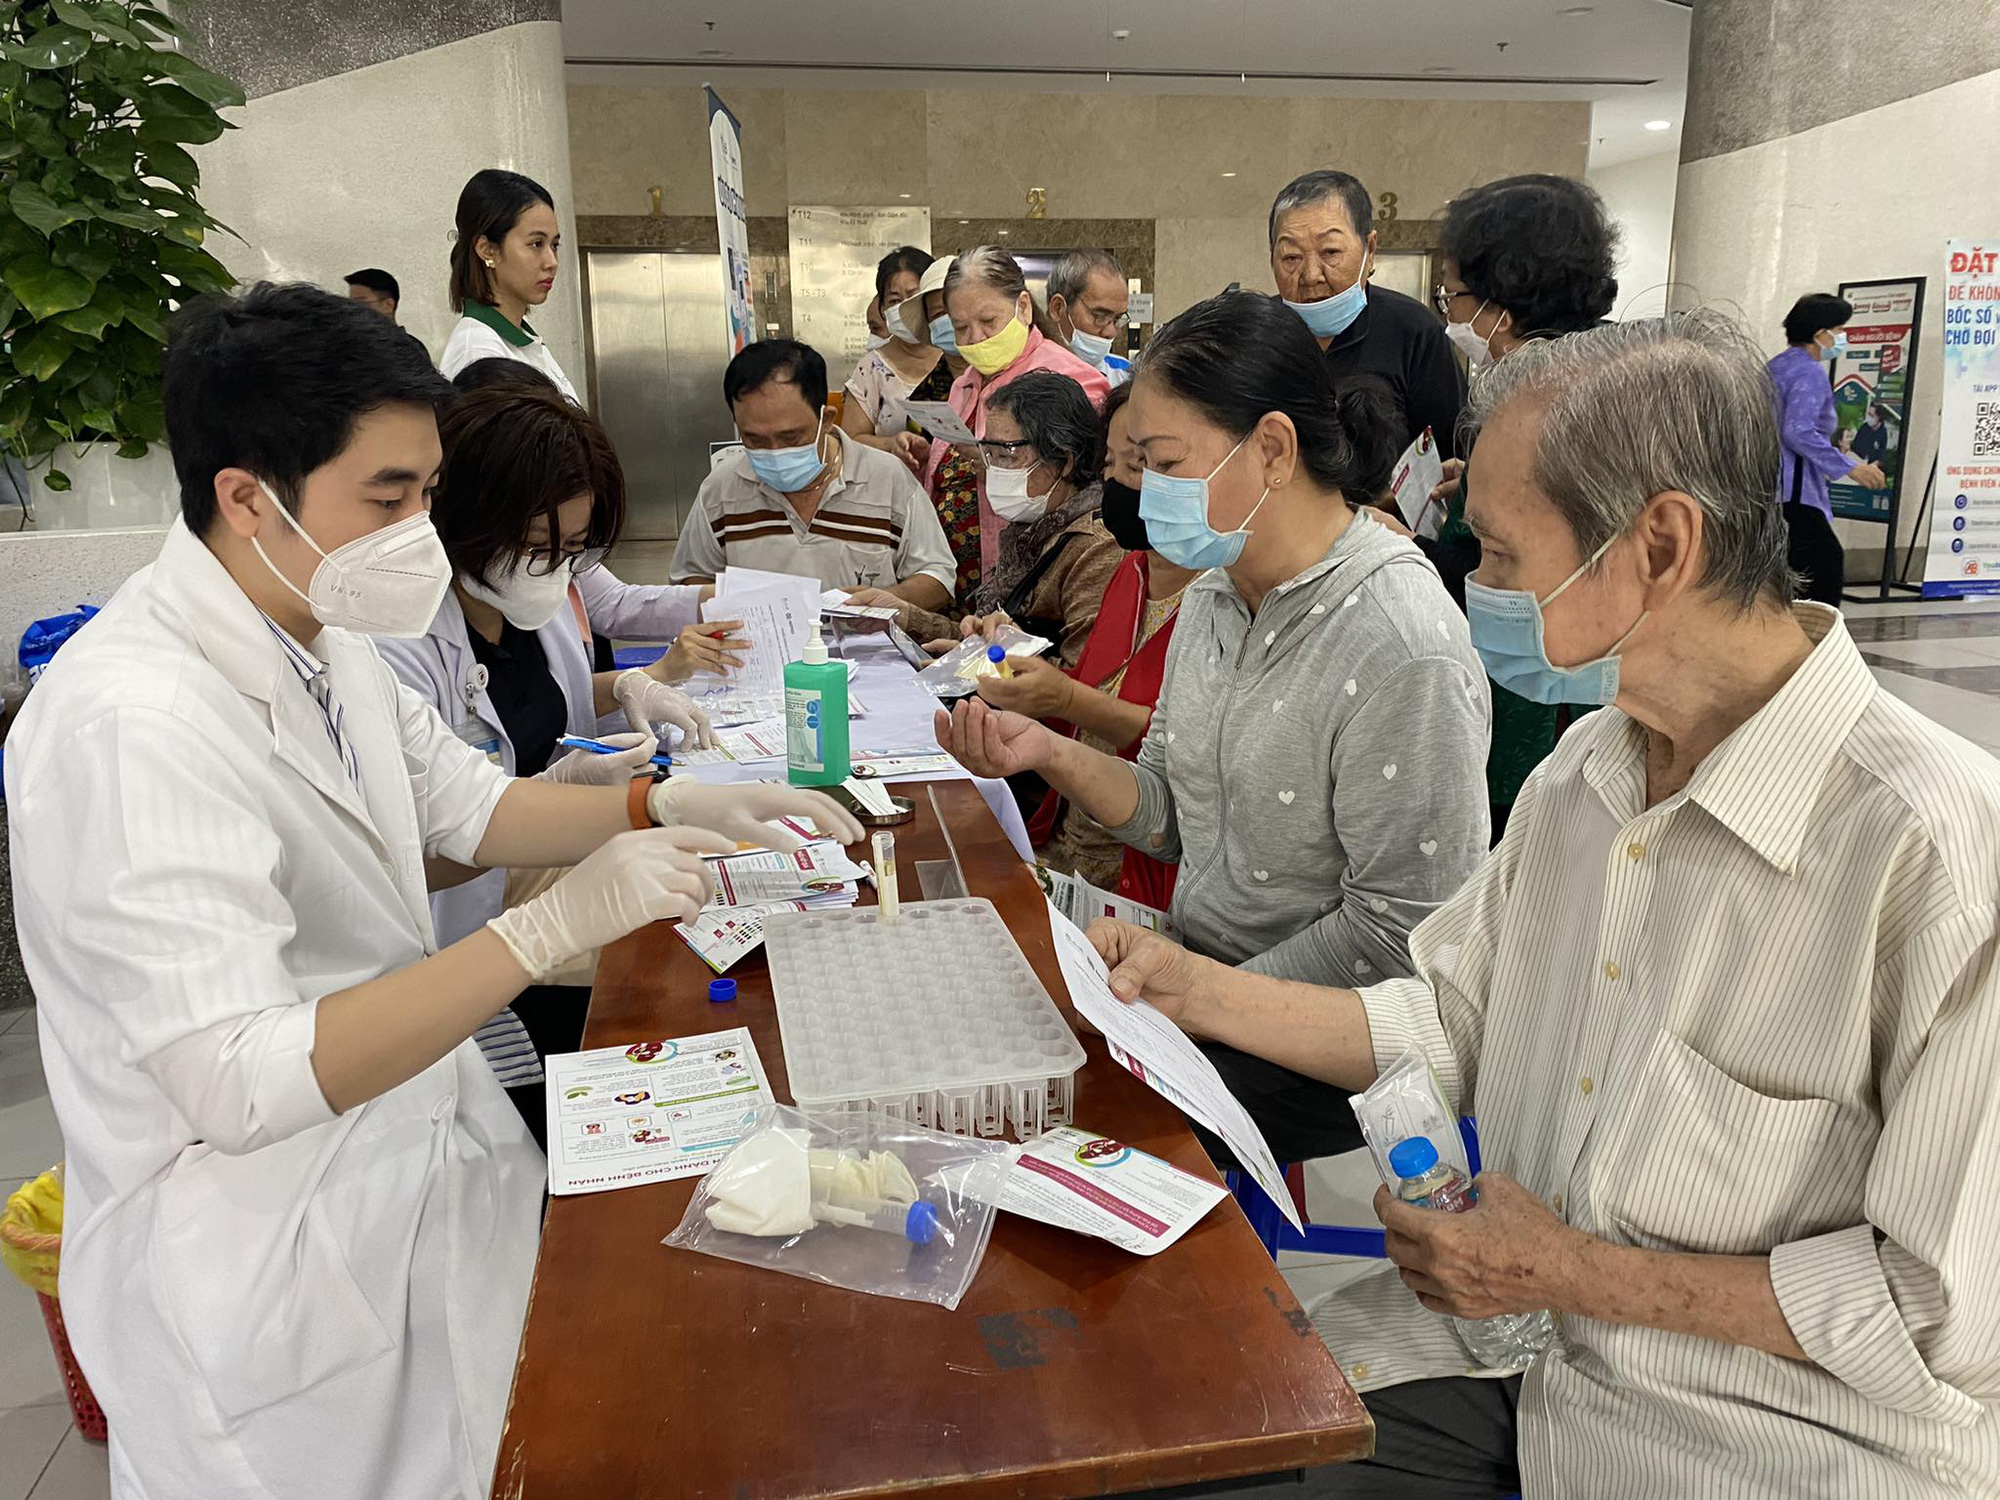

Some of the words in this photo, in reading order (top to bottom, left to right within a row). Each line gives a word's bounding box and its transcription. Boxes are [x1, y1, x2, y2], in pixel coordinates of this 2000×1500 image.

[647, 186, 664, 219] 1
[1026, 188, 1046, 219] 2
[1379, 192, 1398, 221] 3
[797, 210, 812, 220] T12
[798, 238, 812, 247] T11
[800, 262, 813, 271] T10
[1950, 247, 1998, 279] ĐẶT
[802, 313, 812, 323] T4
[1947, 305, 1971, 324] BỐC
[1975, 305, 1992, 324] SỐ
[1974, 327, 1996, 349] ĐỢI
[607, 1171, 643, 1183] BỆNH
[644, 1166, 672, 1178] CHO
[567, 1176, 605, 1187] NHÂN
